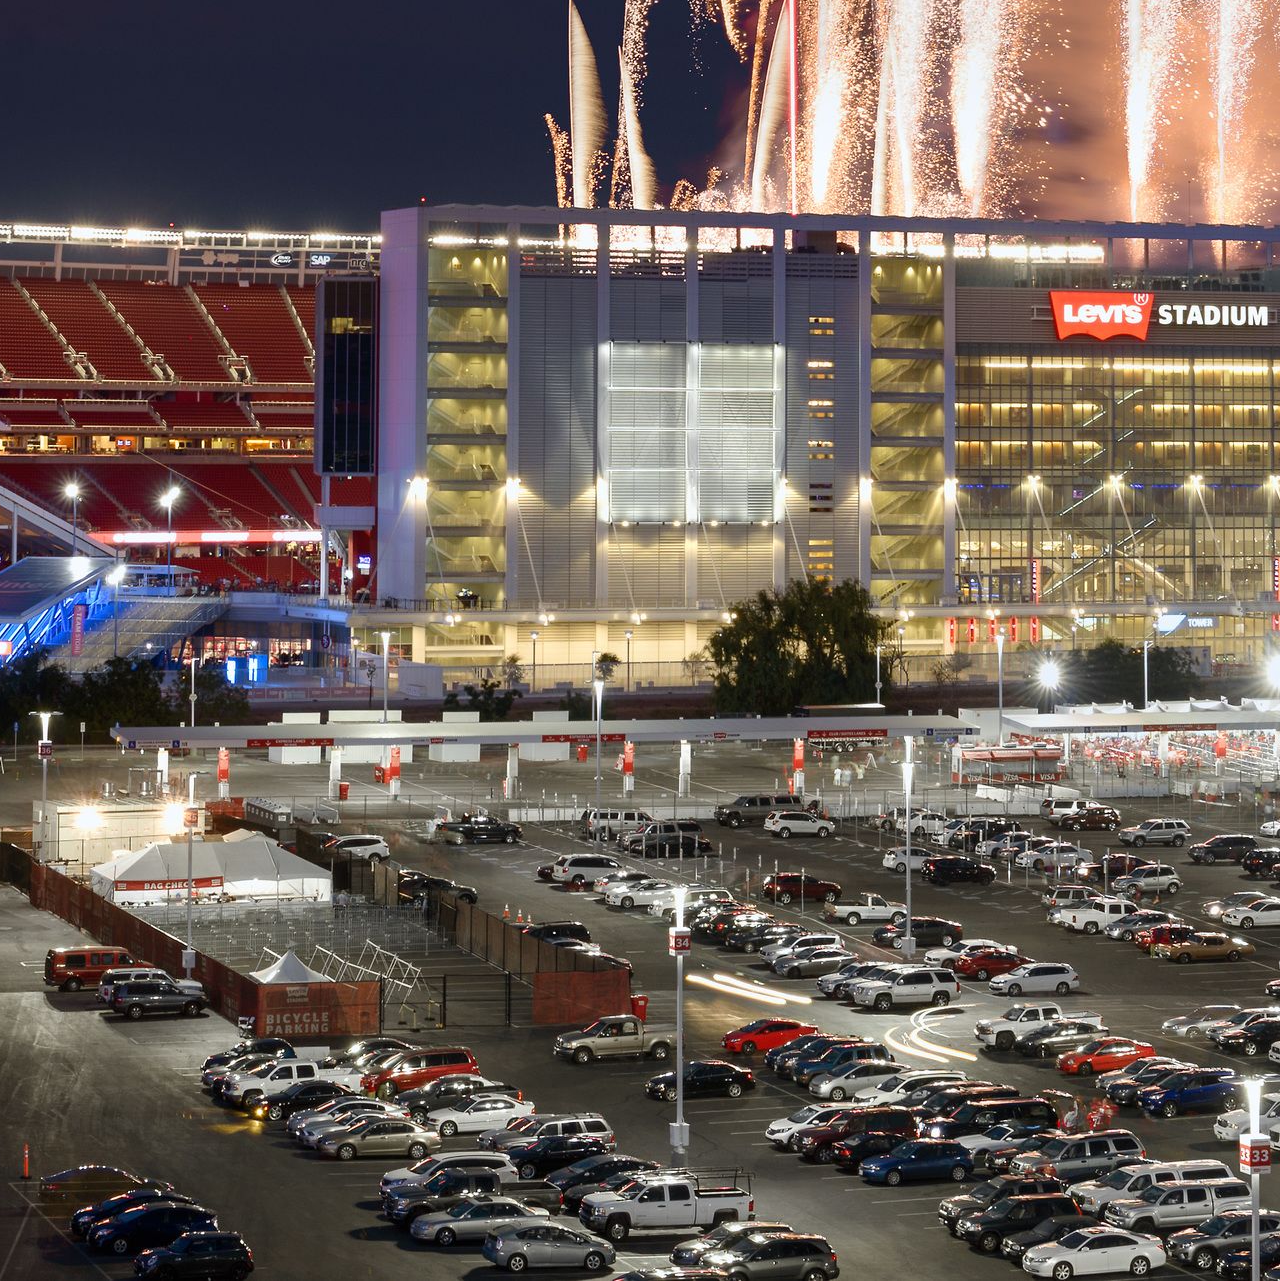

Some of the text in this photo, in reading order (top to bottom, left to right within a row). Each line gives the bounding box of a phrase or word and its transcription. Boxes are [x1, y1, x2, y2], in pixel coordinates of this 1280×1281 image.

[311, 255, 331, 266] SAP
[351, 258, 368, 269] nrg
[1158, 305, 1268, 326] STADIUM
[1188, 618, 1213, 628] TOWER
[144, 881, 196, 890] BAG CHECK
[676, 938, 689, 948] 34
[266, 1012, 329, 1024] BICYCLE
[266, 1023, 329, 1035] PARKING
[1251, 1149, 1269, 1162] 33
